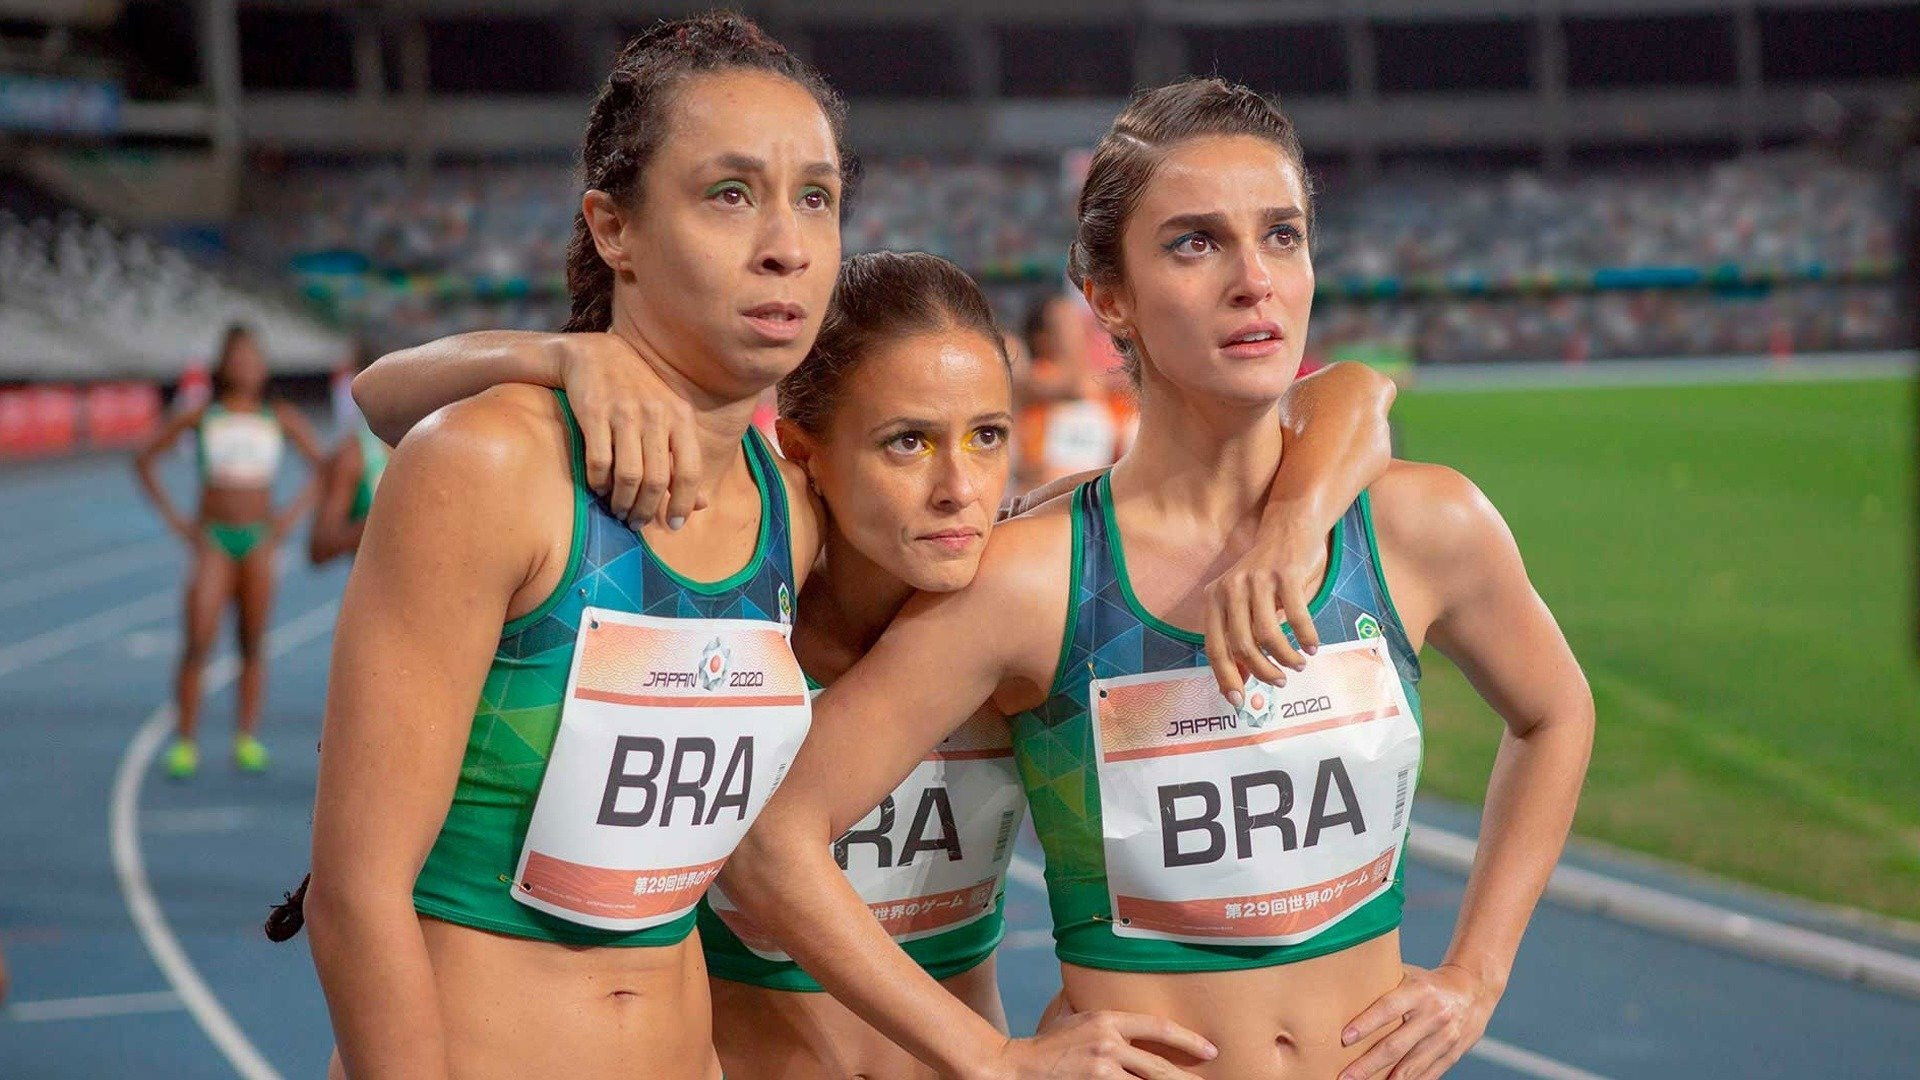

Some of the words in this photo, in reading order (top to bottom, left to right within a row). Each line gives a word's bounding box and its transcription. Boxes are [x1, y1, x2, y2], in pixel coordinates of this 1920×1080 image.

[643, 671, 698, 688] JAPAN
[730, 671, 764, 687] 2020
[1166, 715, 1237, 737] JAPAN
[1281, 695, 1332, 719] 2020
[596, 735, 754, 827] BRA
[833, 787, 963, 871] RA
[1157, 757, 1366, 868] BRA
[873, 894, 963, 919] 世界のゲーム
[1225, 871, 1368, 919] 第29回世界のゲーム
